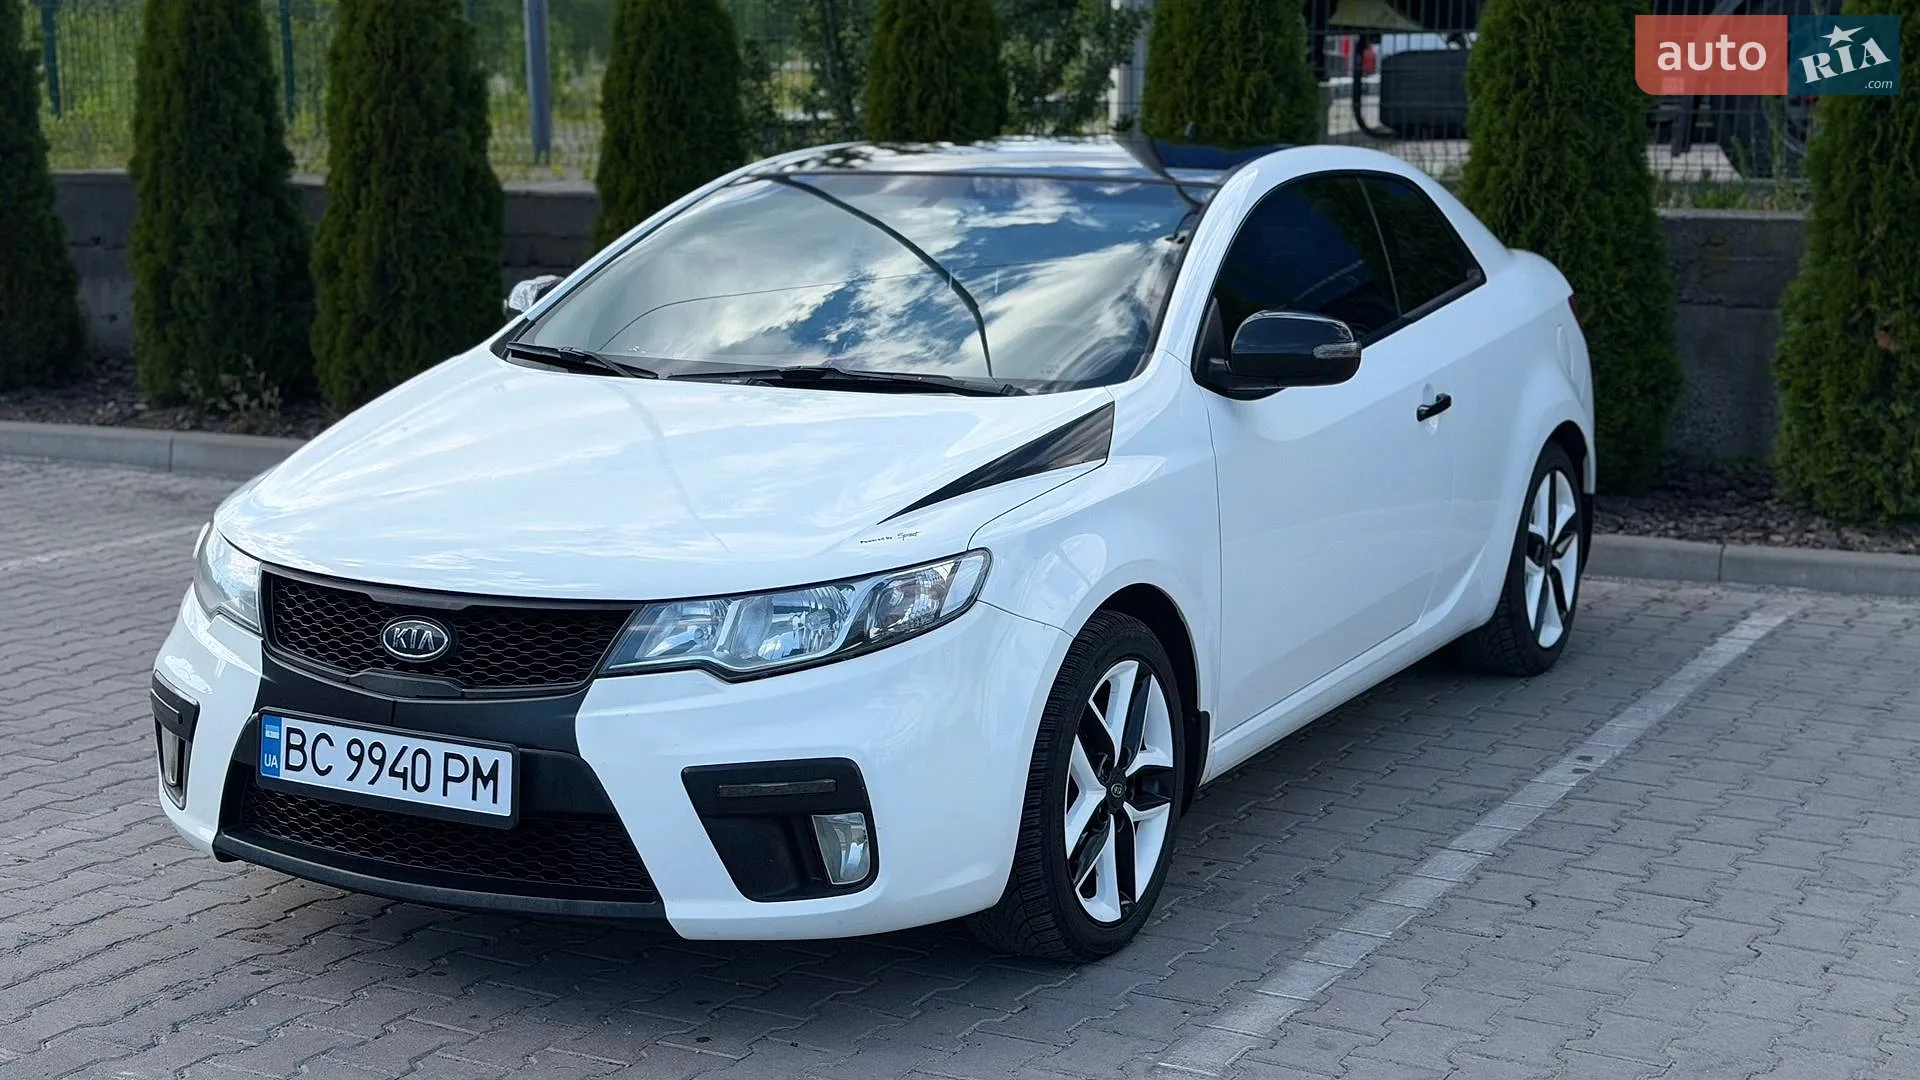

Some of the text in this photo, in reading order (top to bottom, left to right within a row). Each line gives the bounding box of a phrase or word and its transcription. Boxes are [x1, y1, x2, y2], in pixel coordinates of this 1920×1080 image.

[393, 627, 435, 651] KIA
[264, 753, 279, 769] UA
[284, 726, 500, 804] BC 9940 PM
